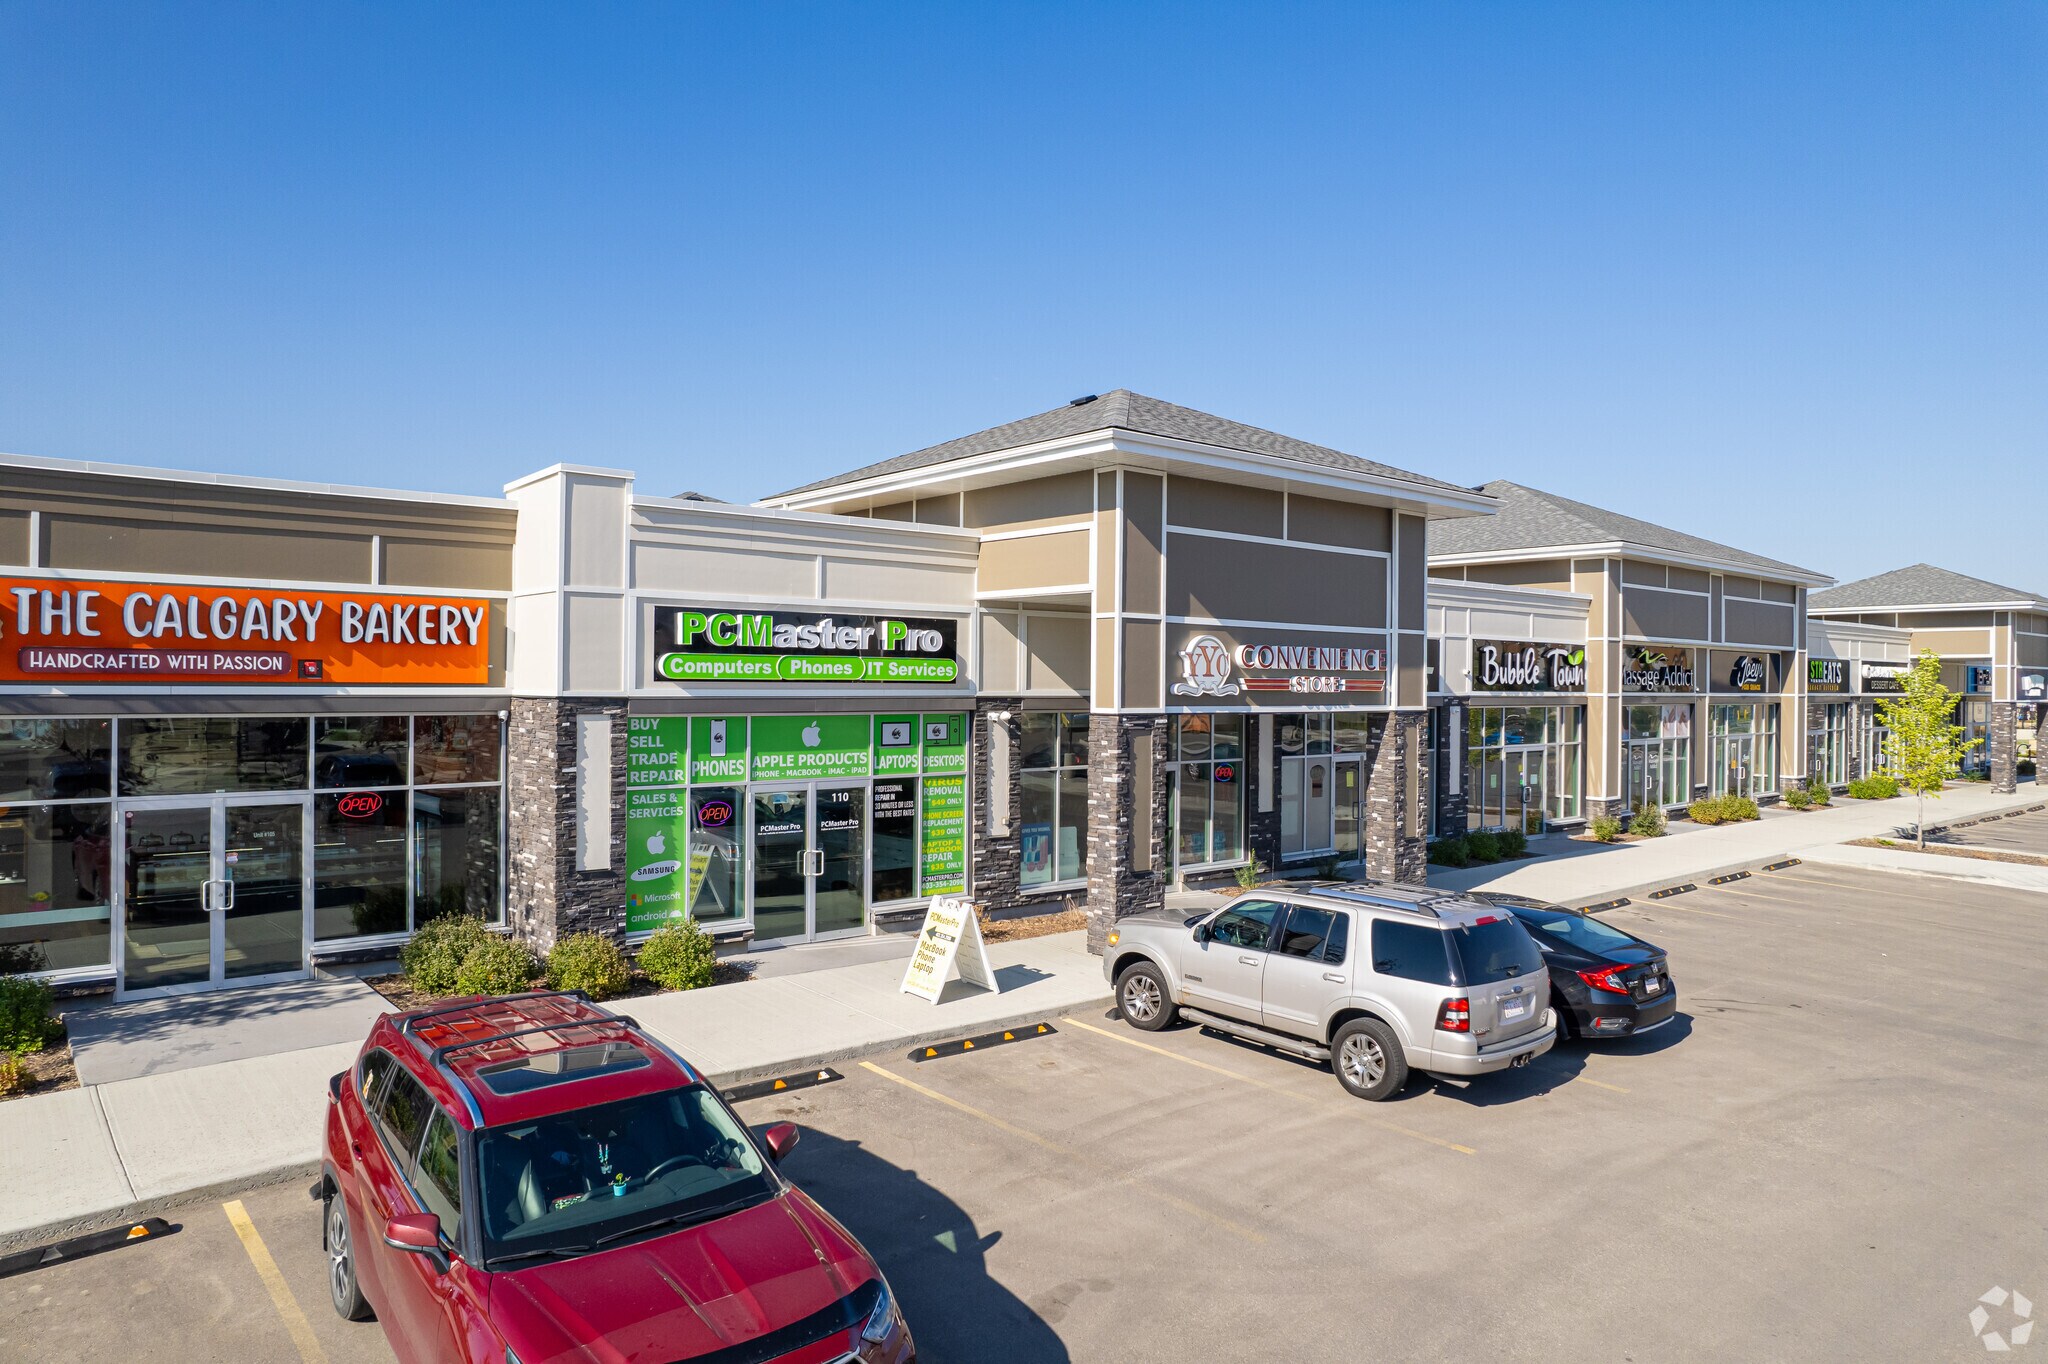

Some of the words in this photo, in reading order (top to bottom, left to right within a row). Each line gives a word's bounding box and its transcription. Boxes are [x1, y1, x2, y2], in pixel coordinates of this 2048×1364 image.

[10, 587, 101, 637] THE
[123, 592, 323, 643] CALGARY
[341, 600, 484, 646] BAKERY
[675, 612, 875, 649] PCMaster
[881, 620, 943, 652] Pro
[29, 651, 160, 669] HANDCRAFTED
[167, 653, 208, 670] WITH
[214, 654, 283, 671] PASSION
[1187, 645, 1229, 677] YYC
[1236, 644, 1387, 671] CONVENIENCE
[670, 658, 772, 677] Computers
[790, 659, 853, 676] Phones
[868, 662, 884, 676] IT
[888, 662, 954, 677] Services
[1482, 645, 1540, 685] Bubble
[1547, 648, 1585, 688] Town
[1664, 665, 1693, 686] Addict
[1291, 676, 1340, 693] STORE
[1871, 680, 1889, 690] DESSERT
[630, 719, 659, 731] BUY
[630, 736, 664, 748] SELL
[630, 753, 677, 765] TRADE
[752, 755, 794, 768] APPLE
[798, 752, 867, 766] PRODUCTS
[874, 754, 918, 769] LAPTOPS
[924, 754, 965, 768] DESKTOPS
[692, 759, 744, 777] PHONES
[752, 770, 780, 778] iPHONE
[786, 768, 822, 776] MACBOOK
[828, 767, 845, 775] iMAC
[1216, 768, 1233, 777] OPEN
[630, 769, 684, 783] REPAIR
[924, 778, 962, 786] VIRUS
[875, 785, 903, 793] PROFESSIONAL
[924, 786, 962, 796] REMOVAL
[632, 793, 666, 805] SALES
[669, 793, 678, 803] &
[832, 792, 849, 802] 110
[875, 793, 890, 801] REPAIR
[341, 797, 378, 812] OPEN
[629, 806, 683, 819] SERVICES
[700, 807, 729, 821] OPEN
[923, 818, 963, 827] REPLACEMENT
[922, 852, 953, 863] REPAIR
[637, 865, 675, 876] SAMSUNG
[644, 892, 681, 903] Microsoft
[631, 910, 667, 922] android
[920, 941, 947, 957] MacBook
[917, 950, 936, 964] Phone
[913, 959, 934, 976] Laptop
